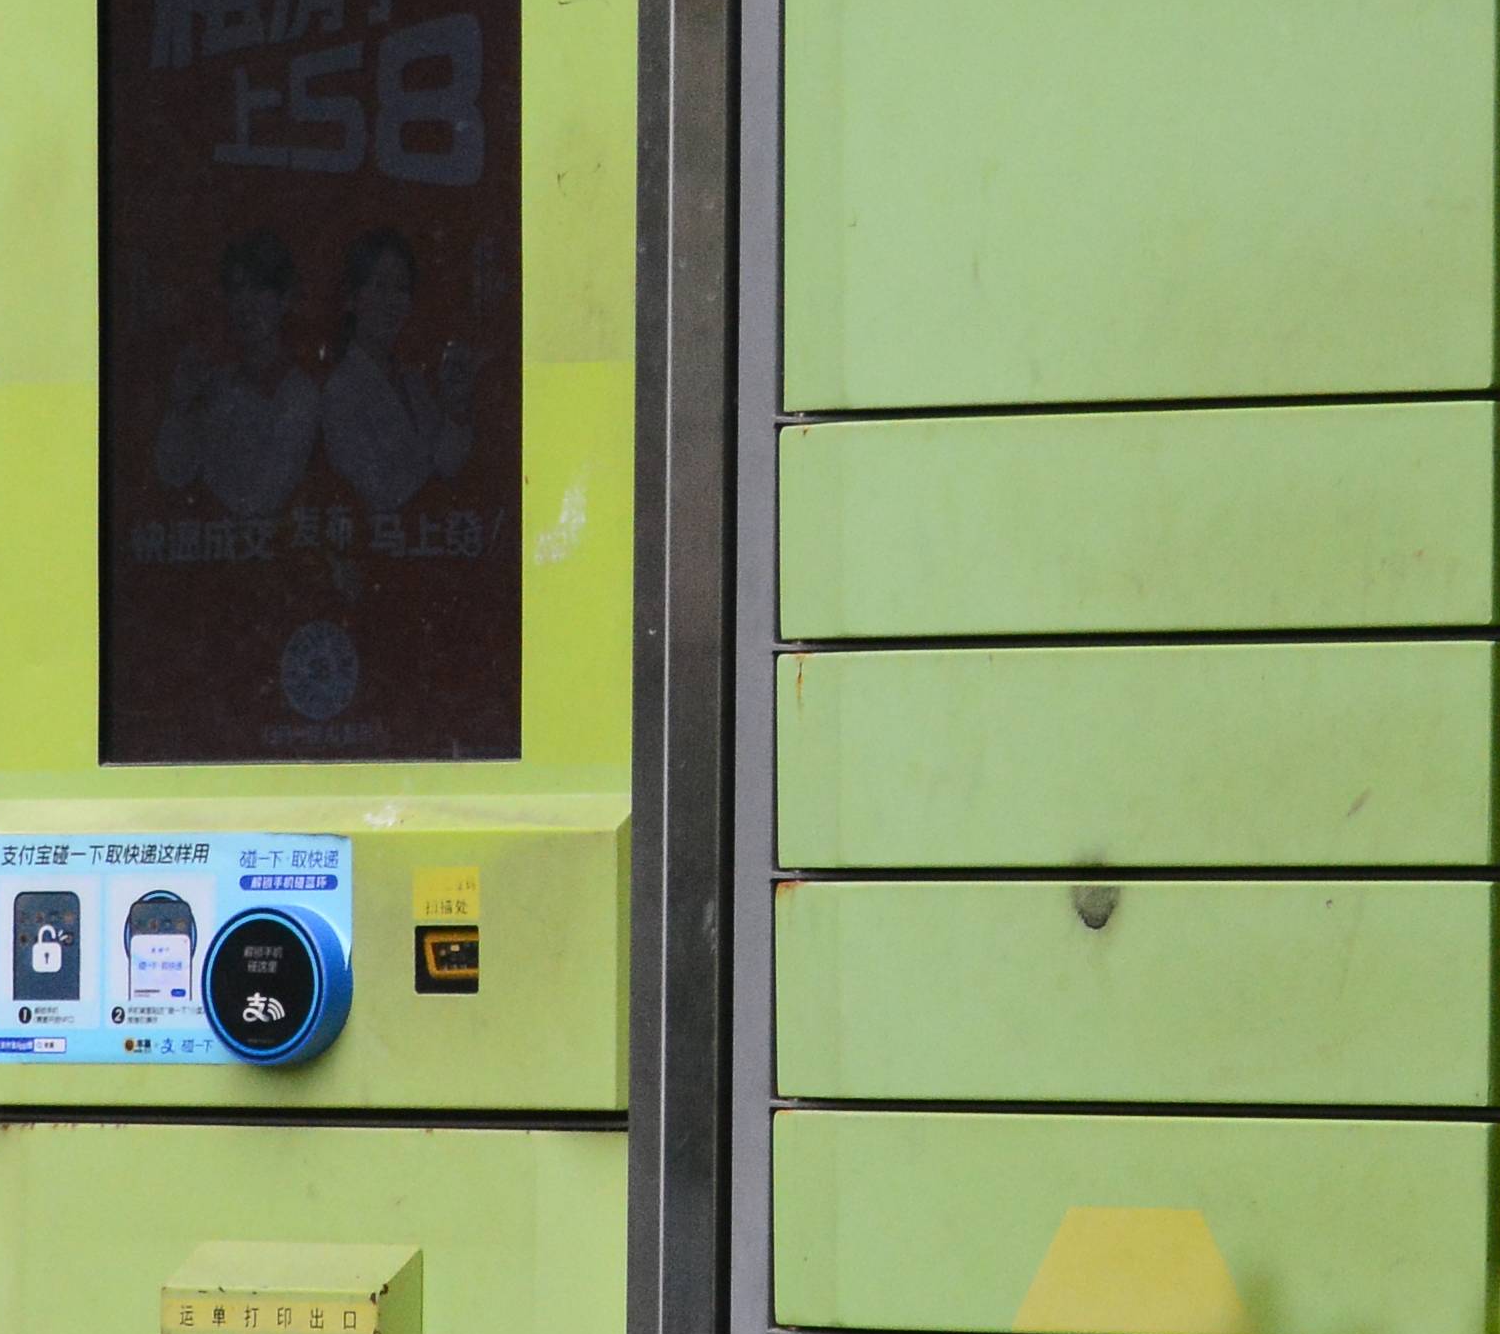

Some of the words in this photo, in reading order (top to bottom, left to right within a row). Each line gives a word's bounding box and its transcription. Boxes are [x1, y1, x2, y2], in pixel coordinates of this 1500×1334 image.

[2, 843, 210, 866] 支付宝碰一下取快递这样用
[179, 1305, 357, 1329] 运单打印出口
